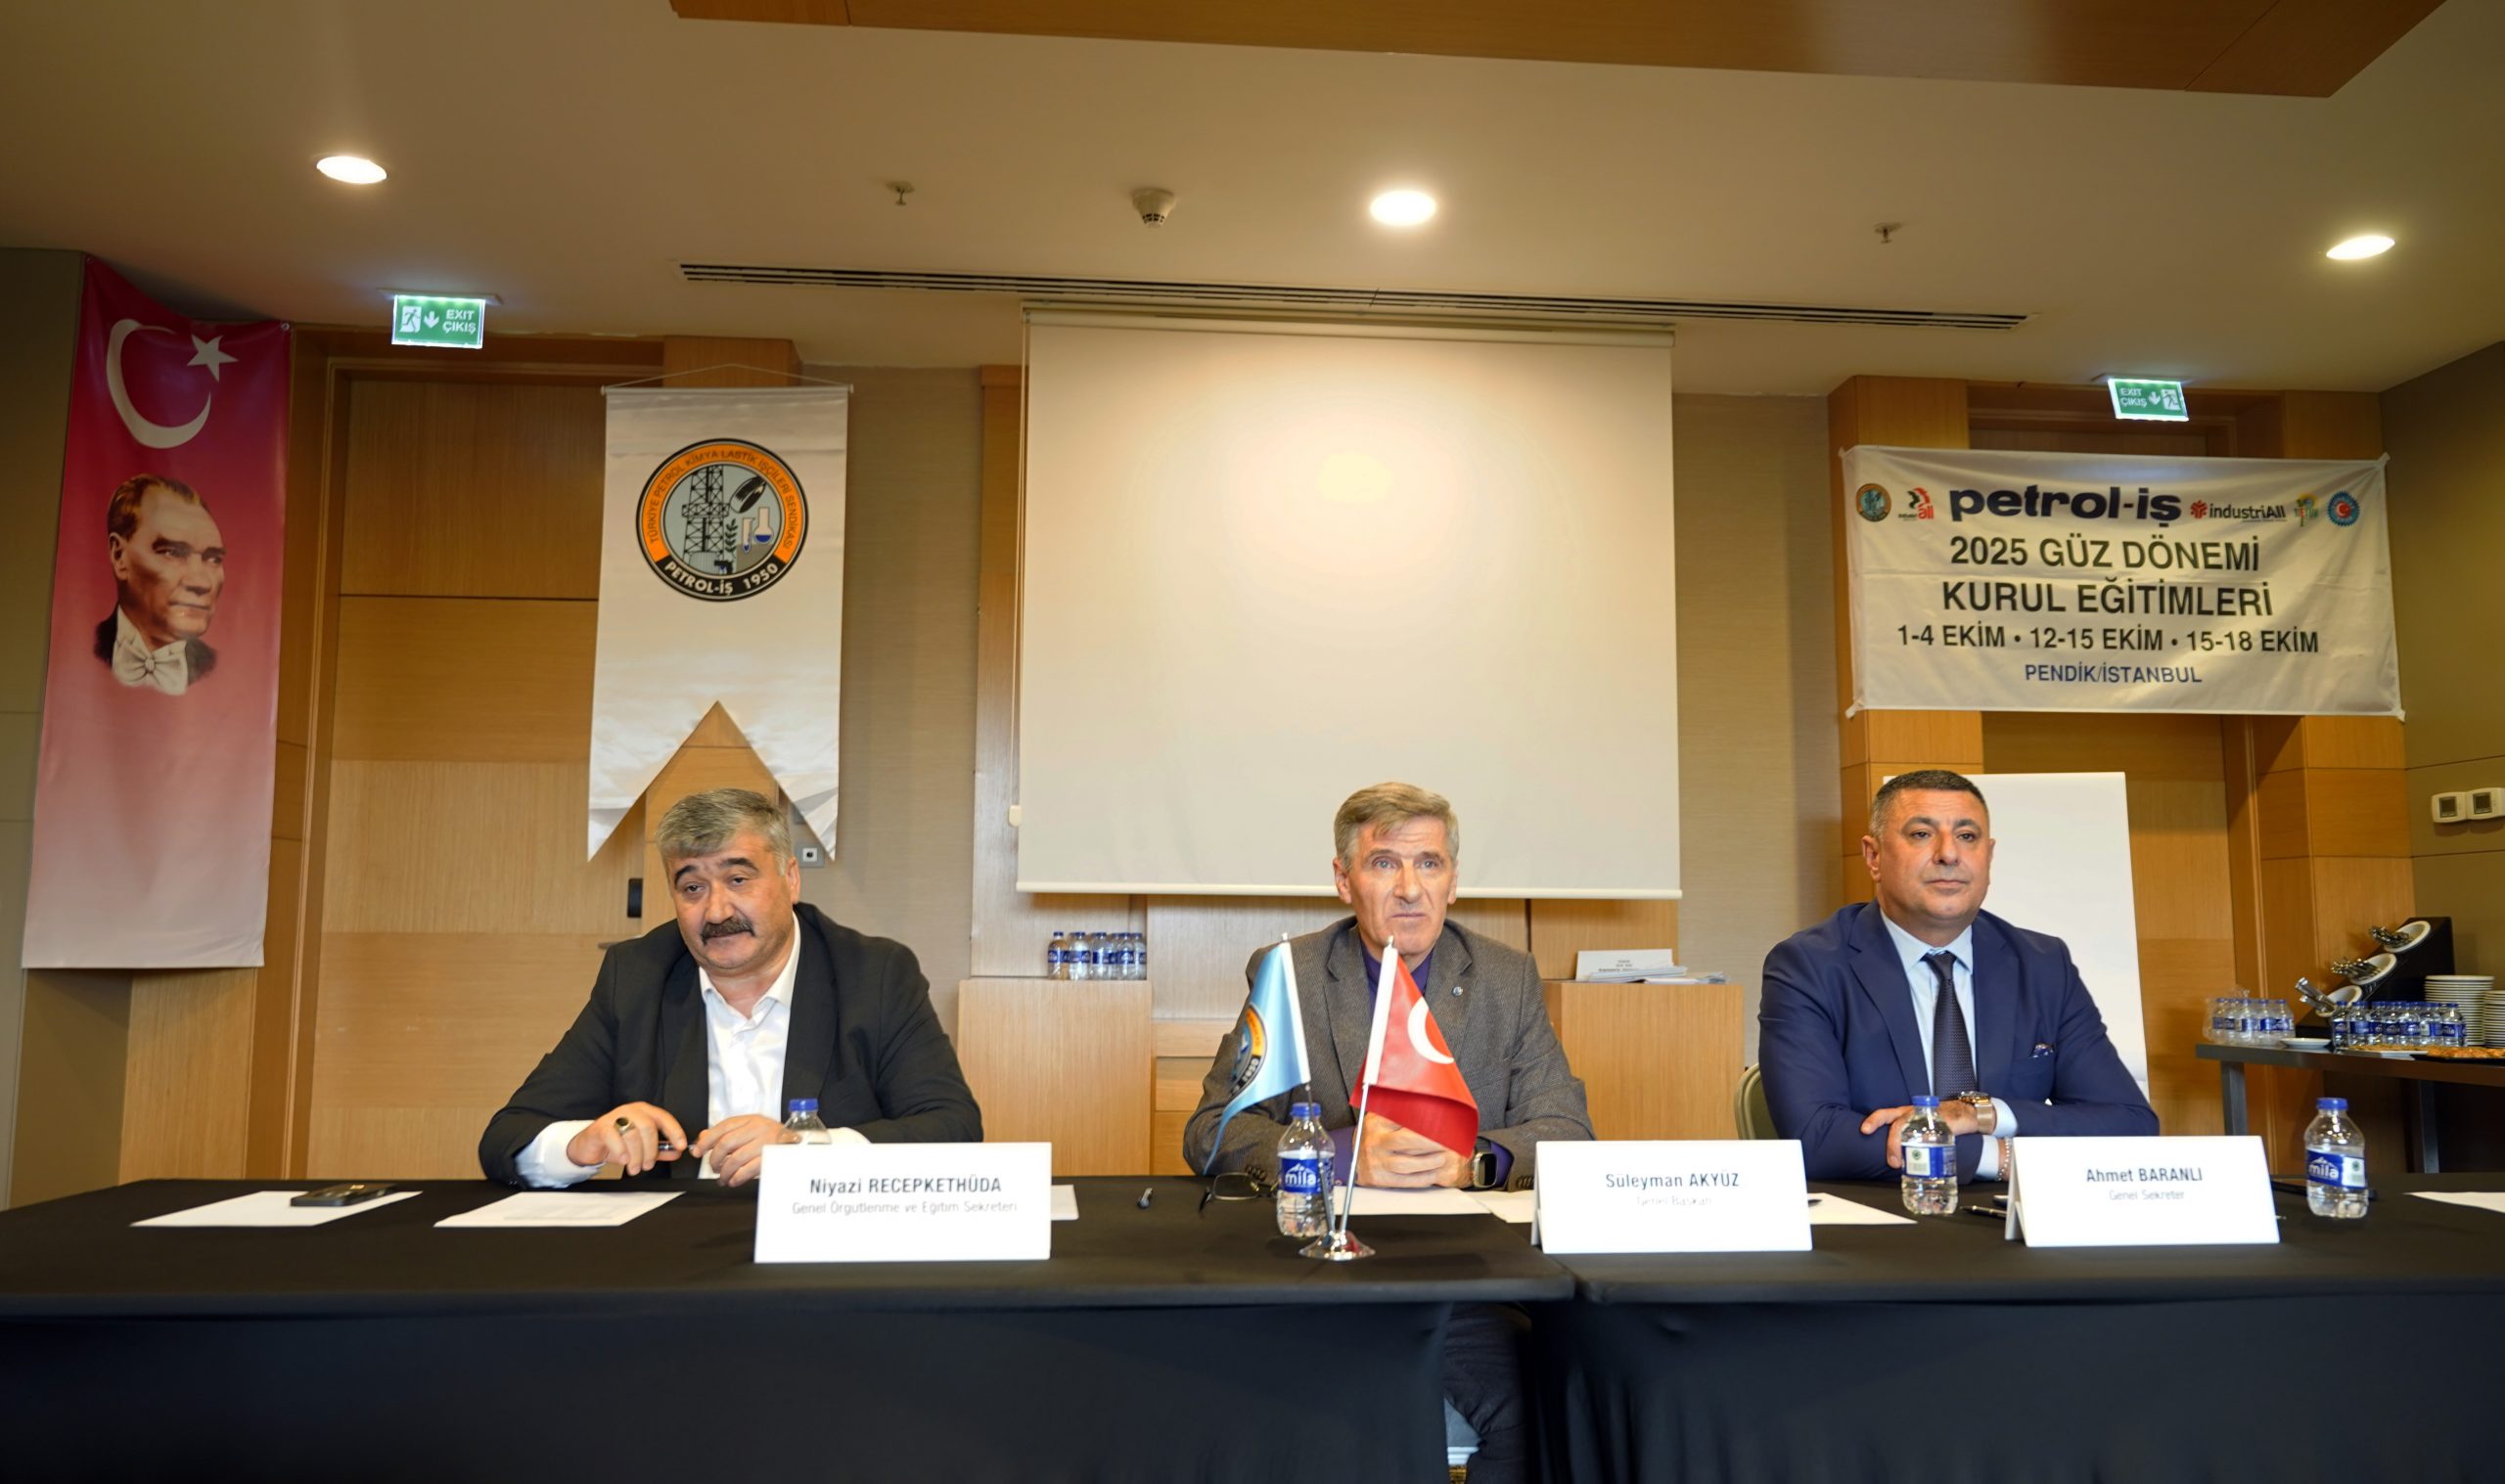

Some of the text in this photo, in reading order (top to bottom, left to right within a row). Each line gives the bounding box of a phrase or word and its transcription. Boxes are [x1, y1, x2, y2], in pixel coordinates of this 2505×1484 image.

[445, 309, 475, 320] EXIT
[442, 321, 477, 335] ÇIKIŞ
[2119, 387, 2142, 396] EXIT
[2120, 397, 2148, 408] ÇIKIŞ
[655, 466, 684, 499] PETROL
[1949, 485, 2181, 527] petrol-iş
[2209, 503, 2286, 519] industriAll
[1950, 532, 2259, 571] 2025 GÜZ DÖNEMİ
[664, 561, 779, 596] PETROL-İŞ 1950
[1942, 575, 2273, 617] KURUL EĞİTİMLERİ
[1897, 620, 2318, 653] 1-4 EKİM 12-15 EKİM 15-18 EKİM
[2025, 660, 2203, 684] PENDİK/İSTANBUL
[1285, 1171, 1316, 1188] mila
[1606, 1170, 1740, 1191] Süleyman AKYÜZ
[2086, 1167, 2203, 1183] Ahmet BARANLI
[2308, 1163, 2340, 1181] mila
[810, 1177, 862, 1196] Niyazi
[2109, 1189, 2185, 1200] Genel Sekreter
[792, 1201, 827, 1214] Genel
[905, 1204, 918, 1213] ve
